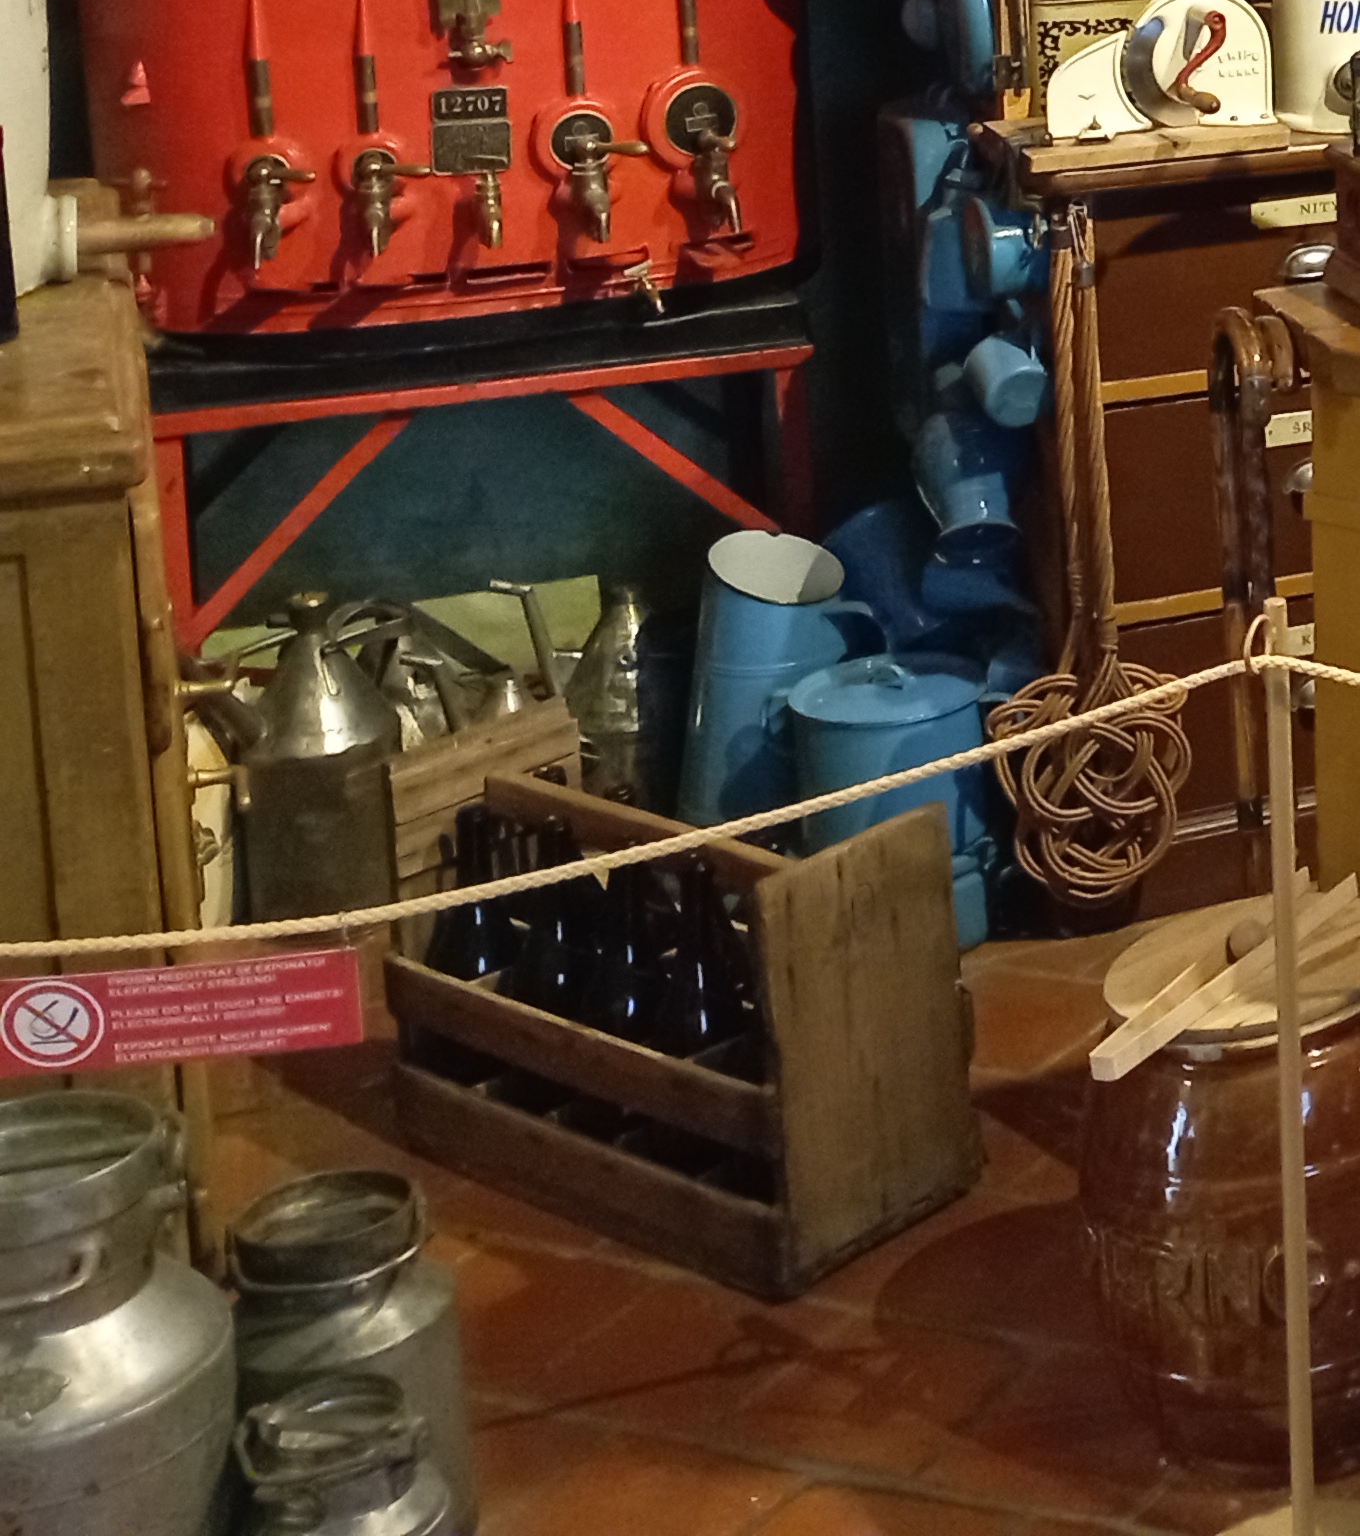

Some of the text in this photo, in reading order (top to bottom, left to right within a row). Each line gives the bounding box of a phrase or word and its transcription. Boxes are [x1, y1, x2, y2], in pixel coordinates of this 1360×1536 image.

[440, 95, 502, 114] 12707
[213, 998, 256, 1011] TOUCH
[258, 995, 282, 1006] THE
